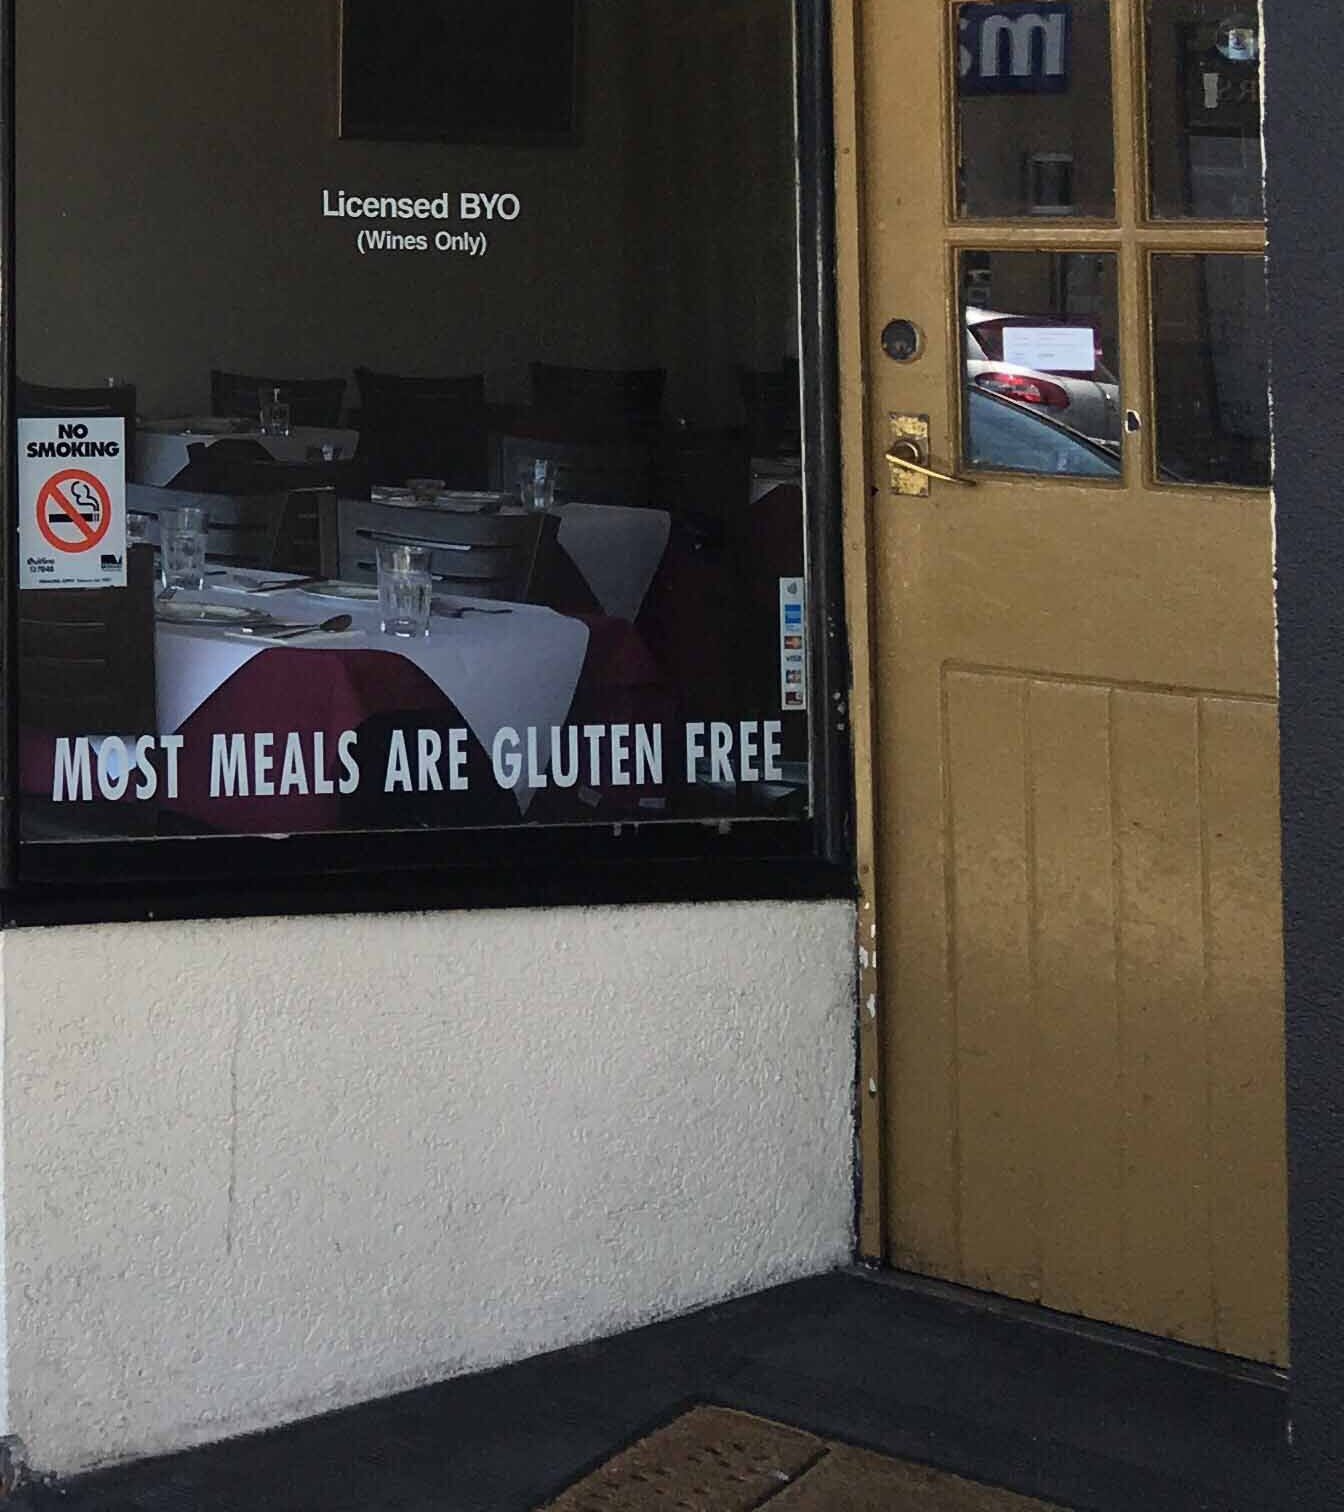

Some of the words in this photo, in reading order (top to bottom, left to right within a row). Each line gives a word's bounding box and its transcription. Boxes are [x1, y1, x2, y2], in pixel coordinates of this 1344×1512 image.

[323, 189, 449, 219] Licensed
[460, 192, 521, 220] BYO
[356, 229, 428, 255] (Wines
[435, 231, 487, 256] Only)
[58, 423, 89, 439] NO
[26, 441, 120, 458] SMOKING
[52, 734, 184, 802] MOST
[210, 728, 362, 796] MEALS
[384, 725, 470, 792] ARE
[492, 719, 664, 790] GLUTEN
[685, 719, 784, 783] FREE
